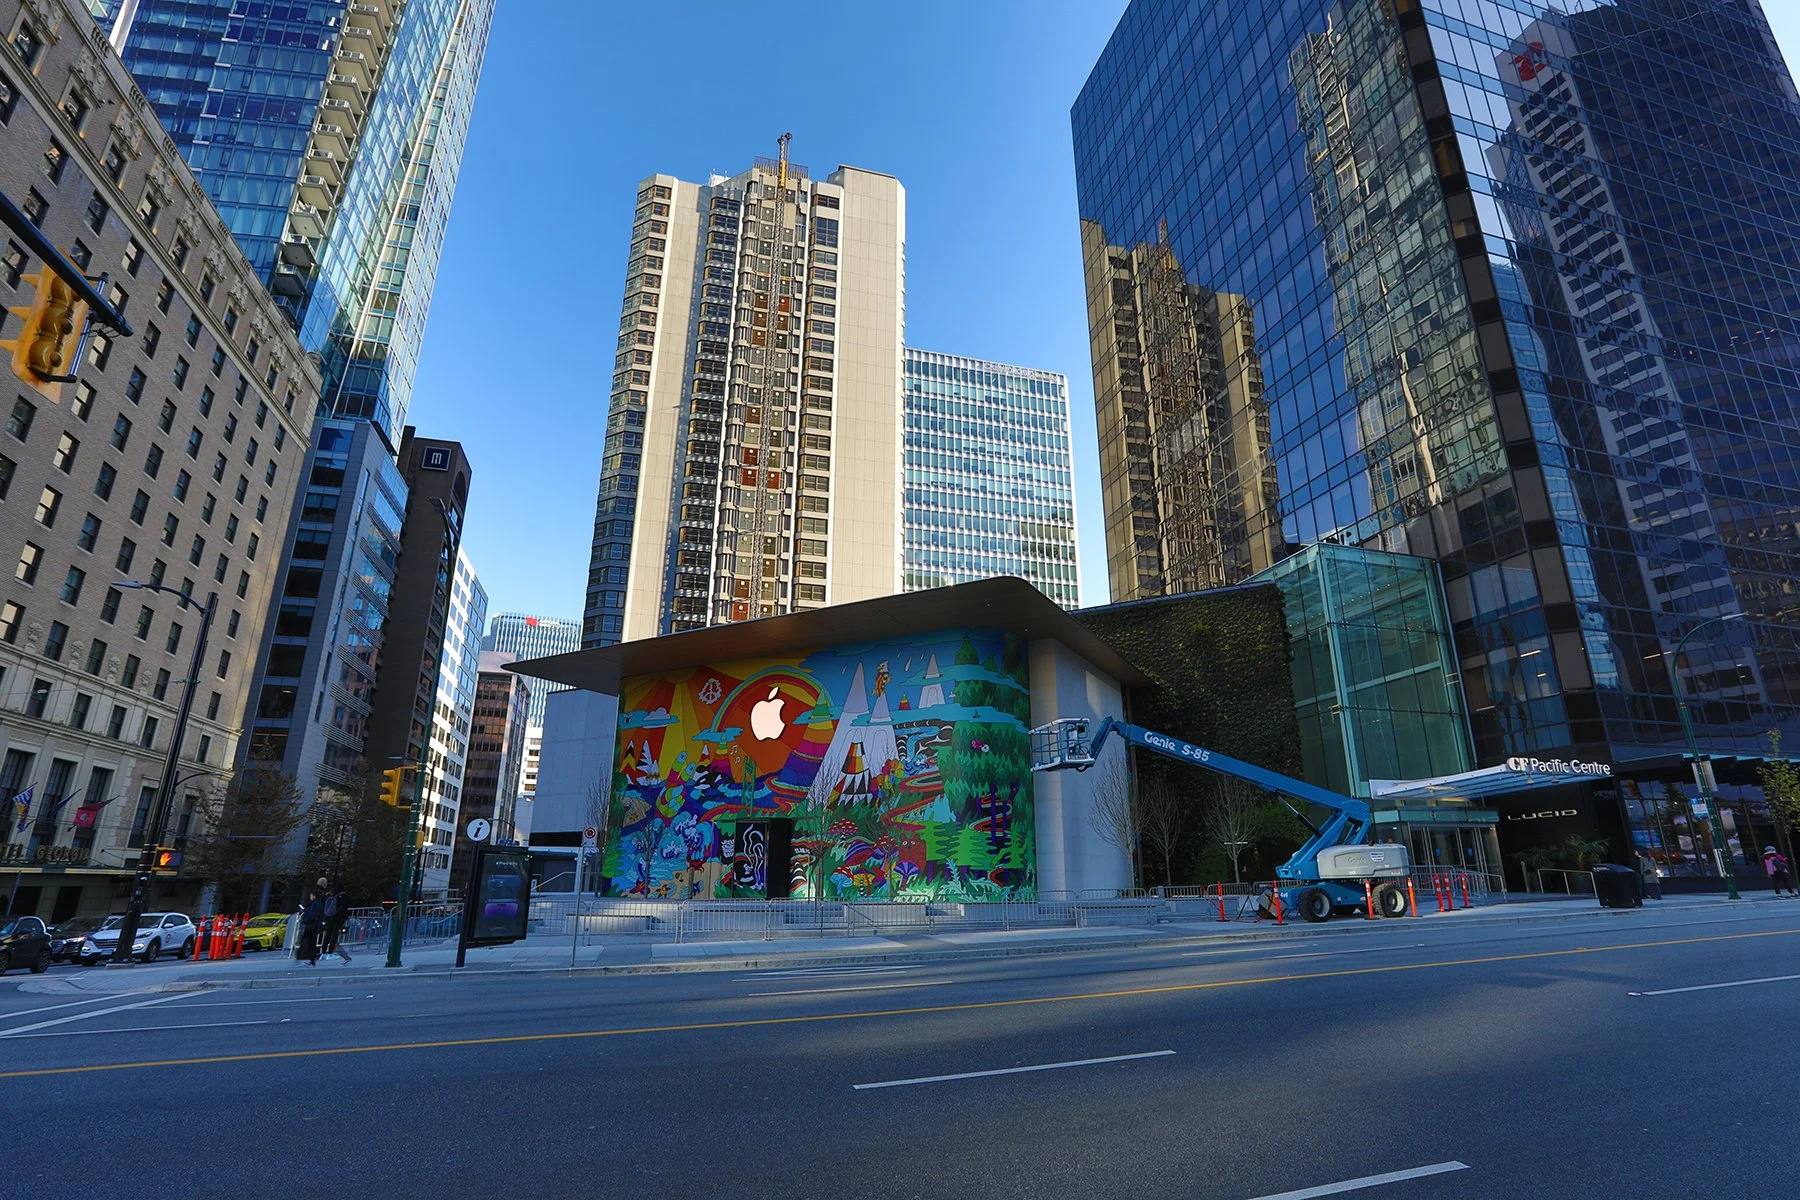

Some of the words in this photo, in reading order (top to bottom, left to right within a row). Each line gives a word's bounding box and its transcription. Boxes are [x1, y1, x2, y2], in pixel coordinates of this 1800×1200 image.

[1144, 731, 1176, 751] Genie
[1181, 744, 1210, 762] S-85
[1507, 757, 1529, 771] CF
[1530, 758, 1569, 773] Pacific
[1570, 759, 1611, 775] Centre
[1507, 809, 1578, 821] LUCID
